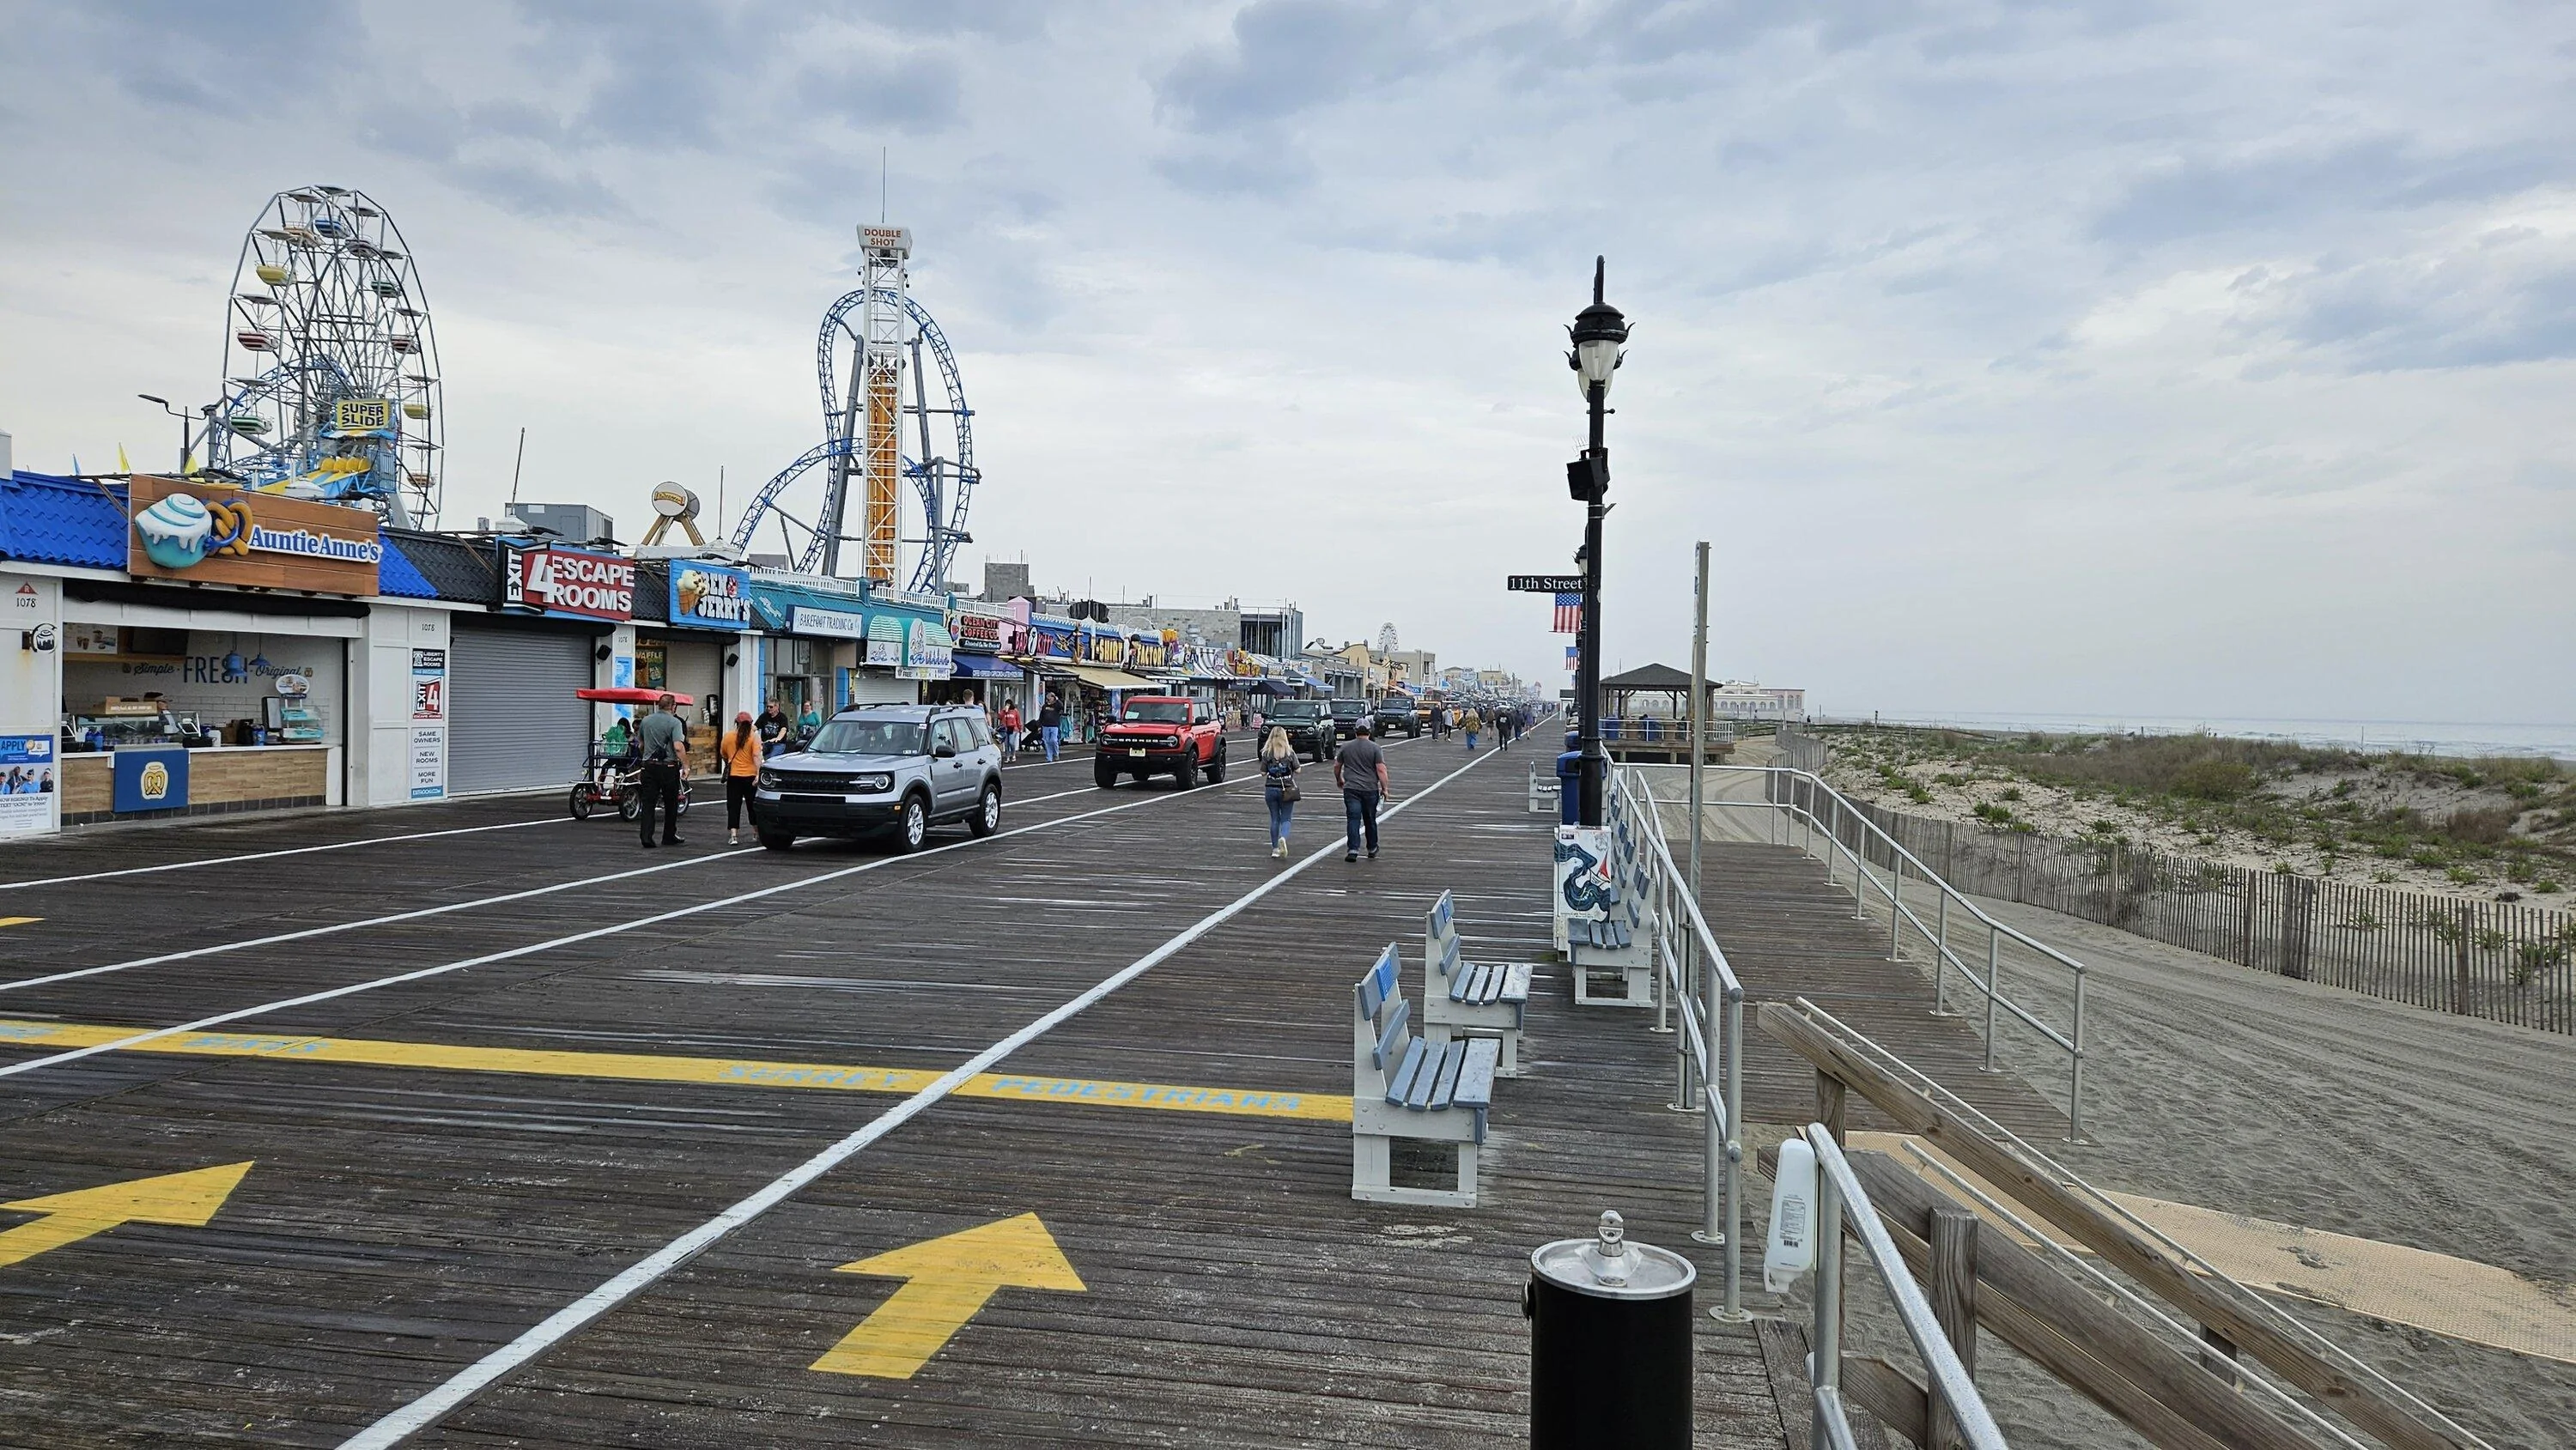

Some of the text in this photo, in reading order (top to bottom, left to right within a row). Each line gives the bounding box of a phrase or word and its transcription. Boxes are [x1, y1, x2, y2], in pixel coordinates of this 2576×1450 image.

[864, 228, 902, 238] DOUBLE
[870, 238, 896, 246] SHOT
[342, 403, 384, 416] SUPER
[342, 414, 384, 427] SLIDE
[507, 549, 555, 604] EXIT 4
[552, 555, 635, 588] ESCAPE
[1510, 577, 1583, 590] 11th Street
[16, 598, 36, 608] 1078
[554, 583, 632, 612] ROOMS
[698, 595, 750, 622] JERRY'S
[422, 623, 435, 632] 1078
[799, 613, 825, 628] BAREFOOT
[963, 616, 999, 629] OCEAN CIT
[963, 628, 988, 639] COFFEE
[1016, 631, 1028, 651] BAD
[1091, 637, 1123, 663] T-SHIRT
[1137, 643, 1167, 667] FACTORY
[134, 662, 175, 676] Simple
[255, 665, 301, 679] Original
[416, 684, 439, 710] EXIT 4
[1, 740, 26, 751] APPLY
[991, 1077, 1302, 1110] PEDESTRIANS
